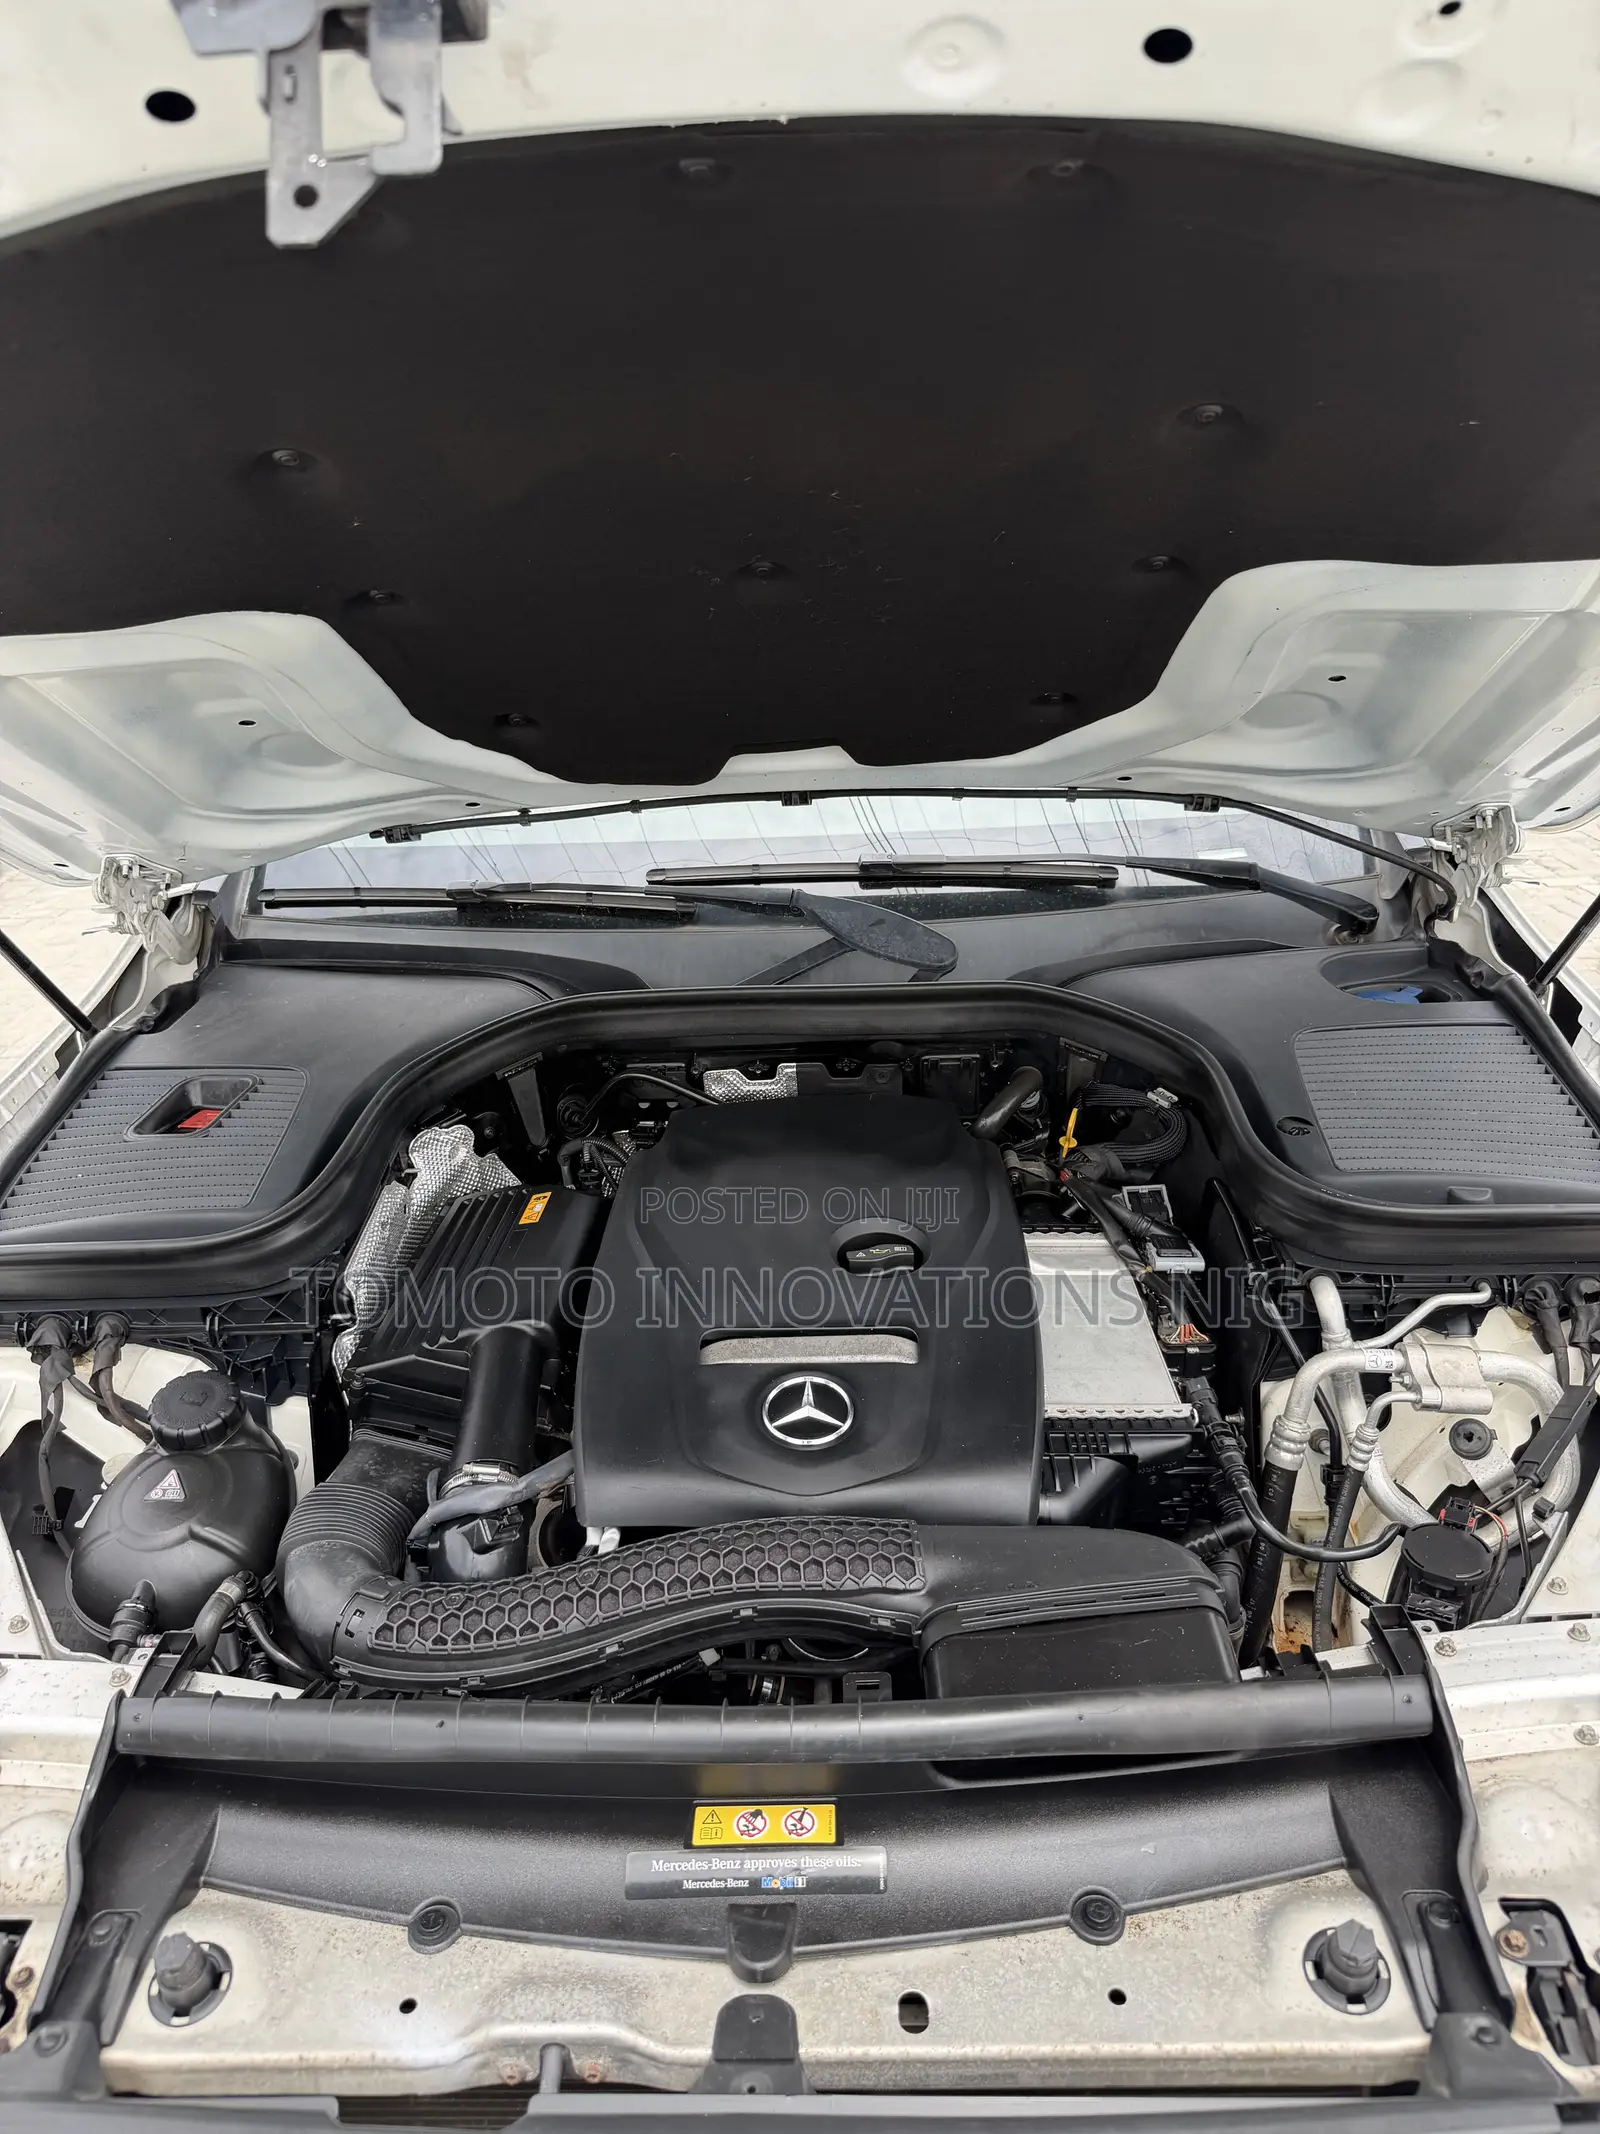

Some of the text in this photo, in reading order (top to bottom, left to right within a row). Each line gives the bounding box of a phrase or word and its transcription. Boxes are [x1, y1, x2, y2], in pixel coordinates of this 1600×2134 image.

[651, 1857, 742, 1872] Mercedes-Benz
[743, 1858, 798, 1872] approves
[800, 1855, 834, 1869] these
[682, 1878, 750, 1890] Mercedes-Benz
[761, 1876, 794, 1889] Mobil
